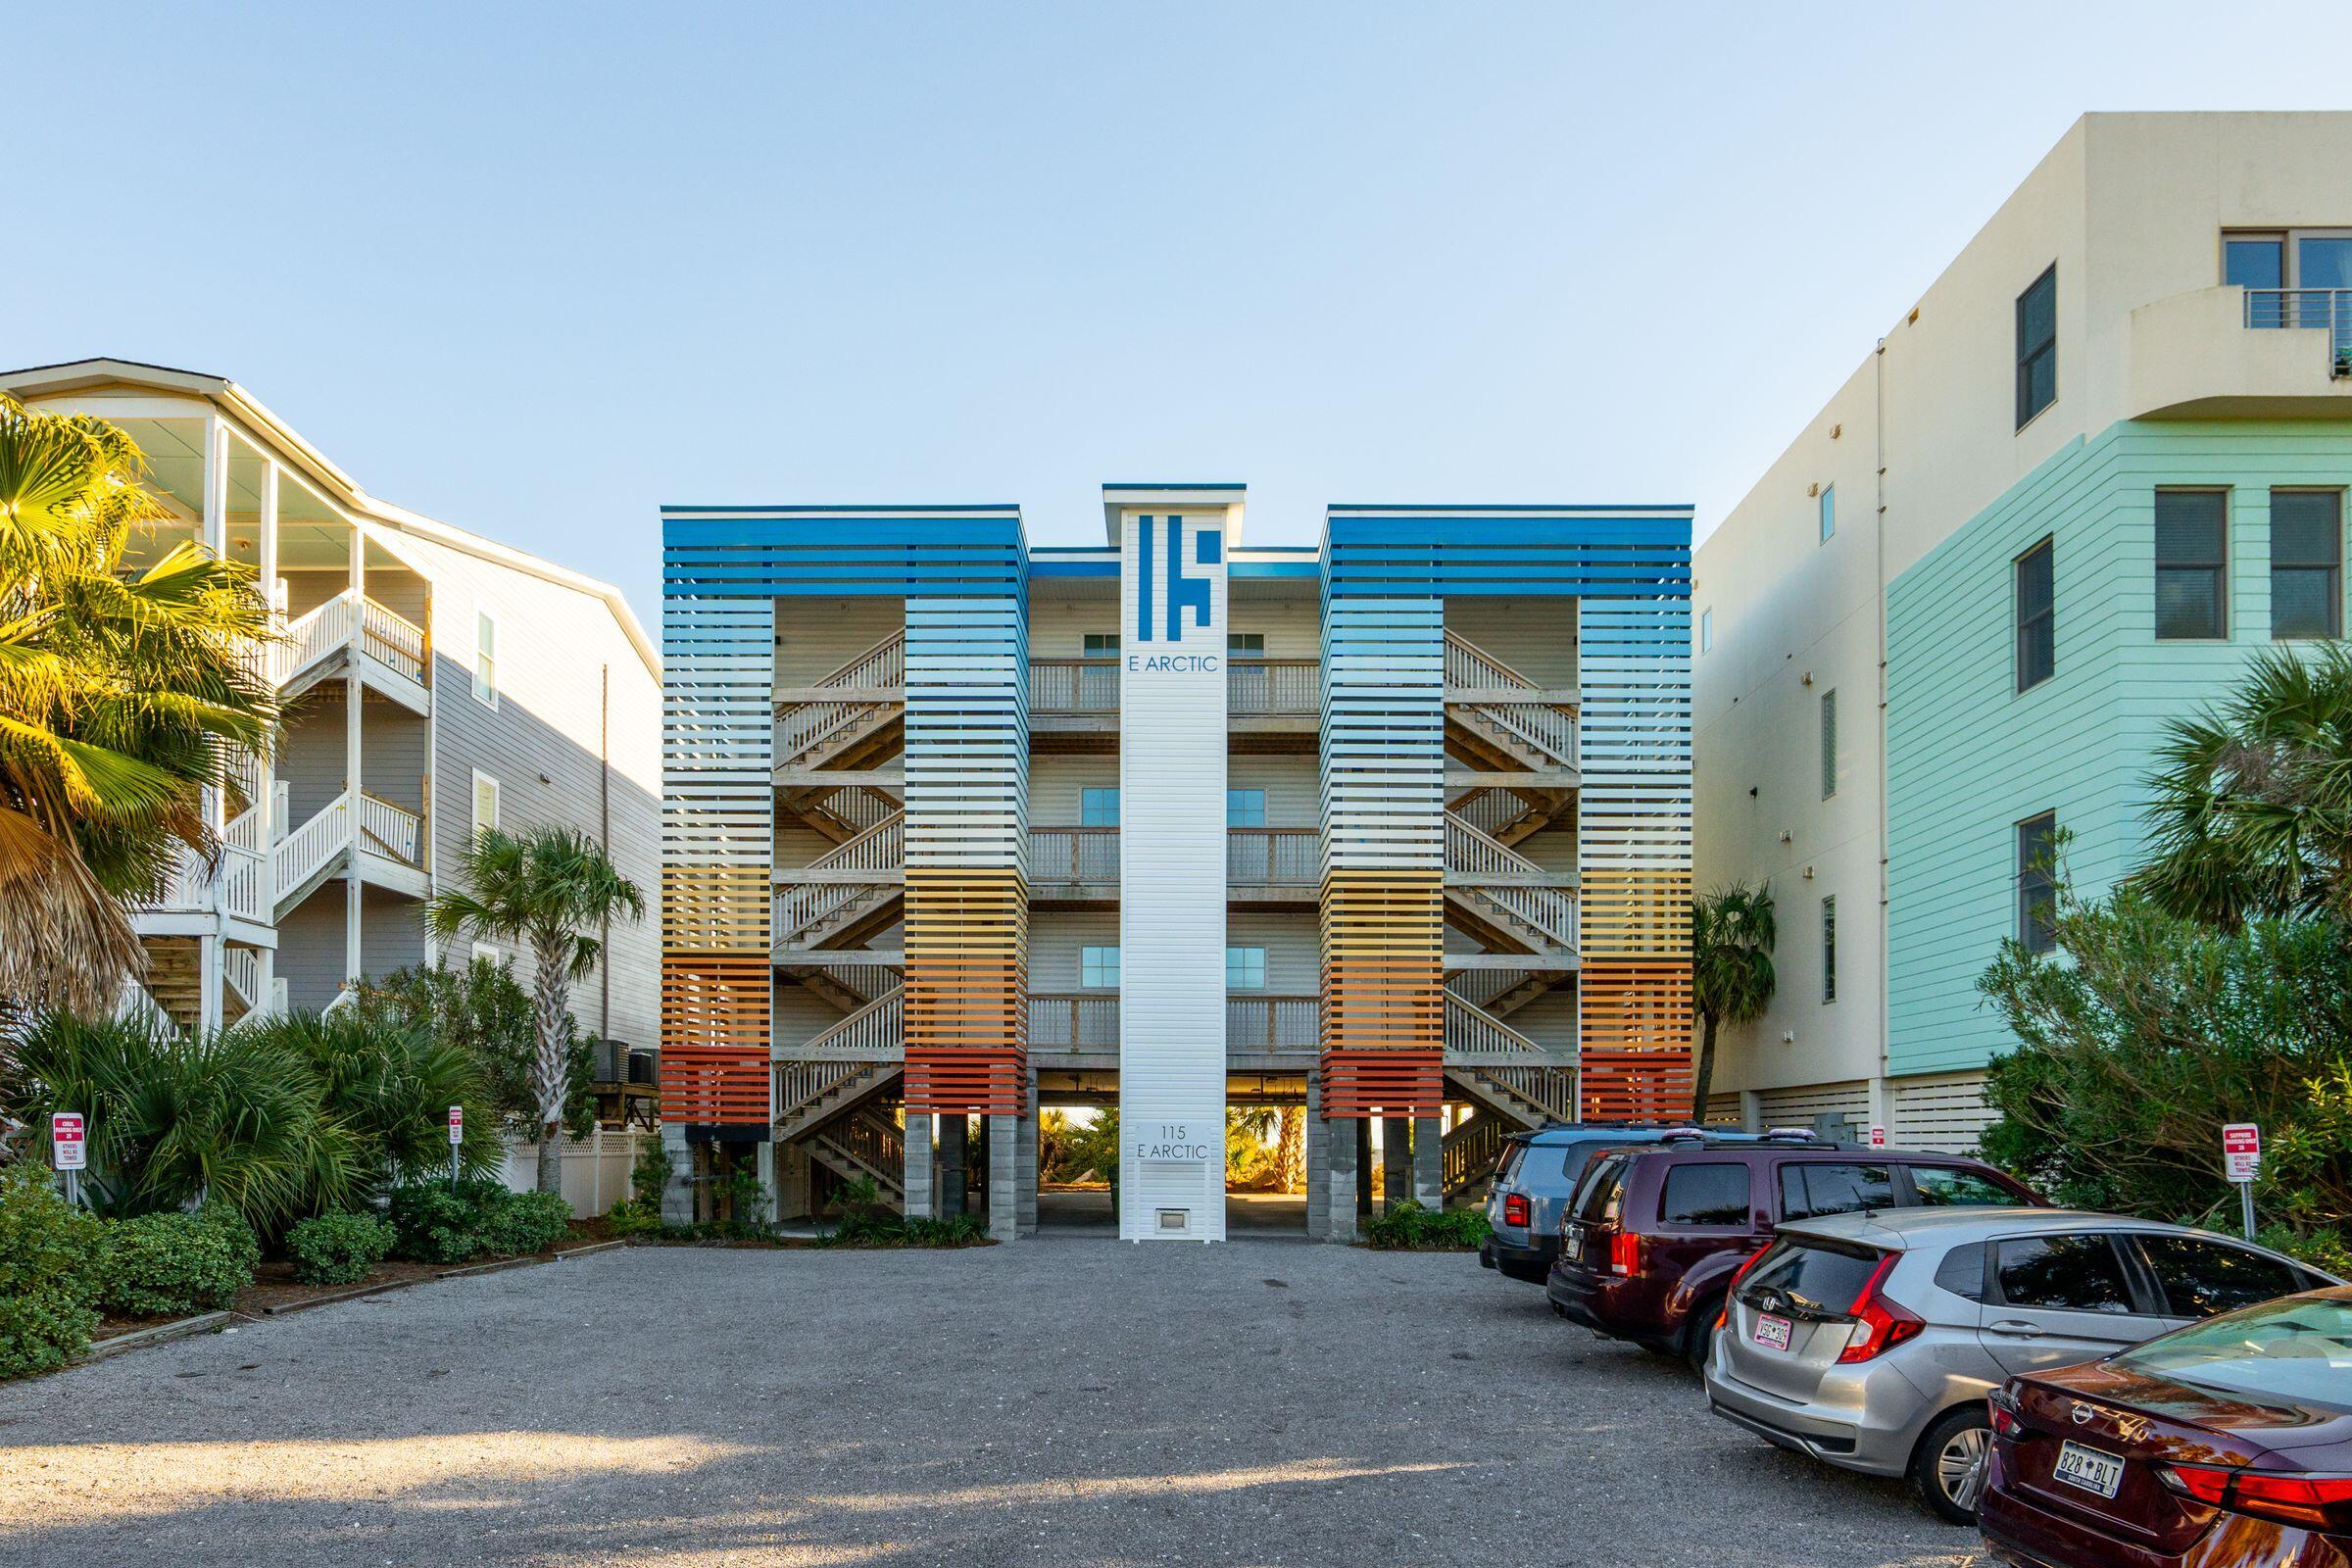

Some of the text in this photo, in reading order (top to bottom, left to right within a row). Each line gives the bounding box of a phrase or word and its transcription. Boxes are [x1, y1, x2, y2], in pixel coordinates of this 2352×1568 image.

[1129, 656, 1218, 672] E ARCTIC
[1161, 1125, 1186, 1140] 115
[1138, 1144, 1208, 1159] E ARCTIC
[2061, 1451, 2119, 1486] 828 BLT
[2067, 1474, 2101, 1491] SOUTH CAROLINA
